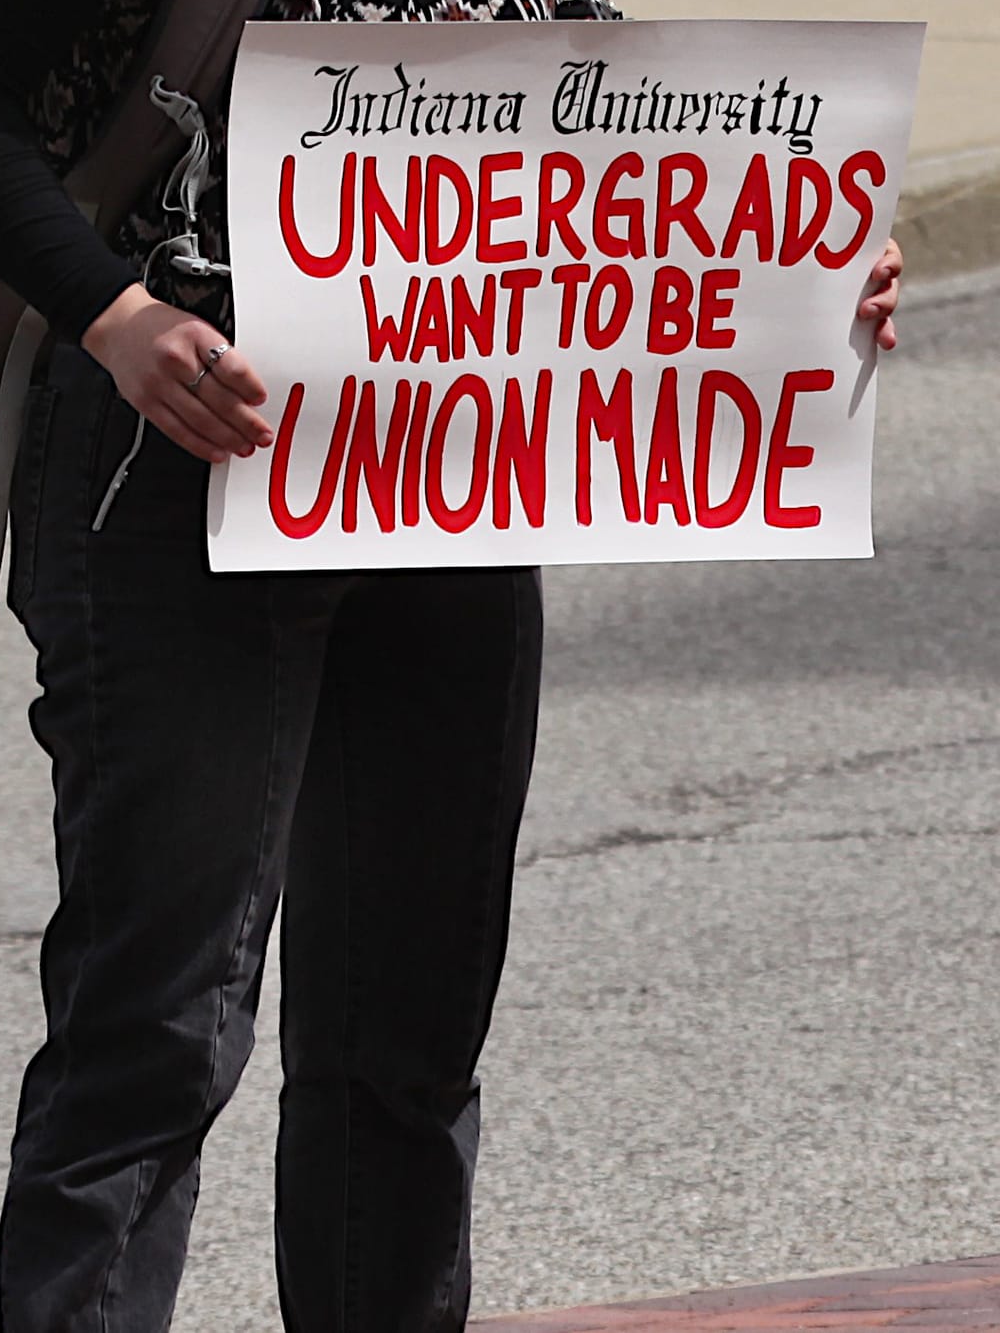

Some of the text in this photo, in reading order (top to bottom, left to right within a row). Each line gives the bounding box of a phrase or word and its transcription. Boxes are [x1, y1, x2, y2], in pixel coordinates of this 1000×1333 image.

[300, 59, 824, 155] Indiana University
[278, 150, 887, 279] UNDERGRADS
[360, 264, 741, 364] WANT TO BE
[268, 366, 835, 540] UNION MADE
